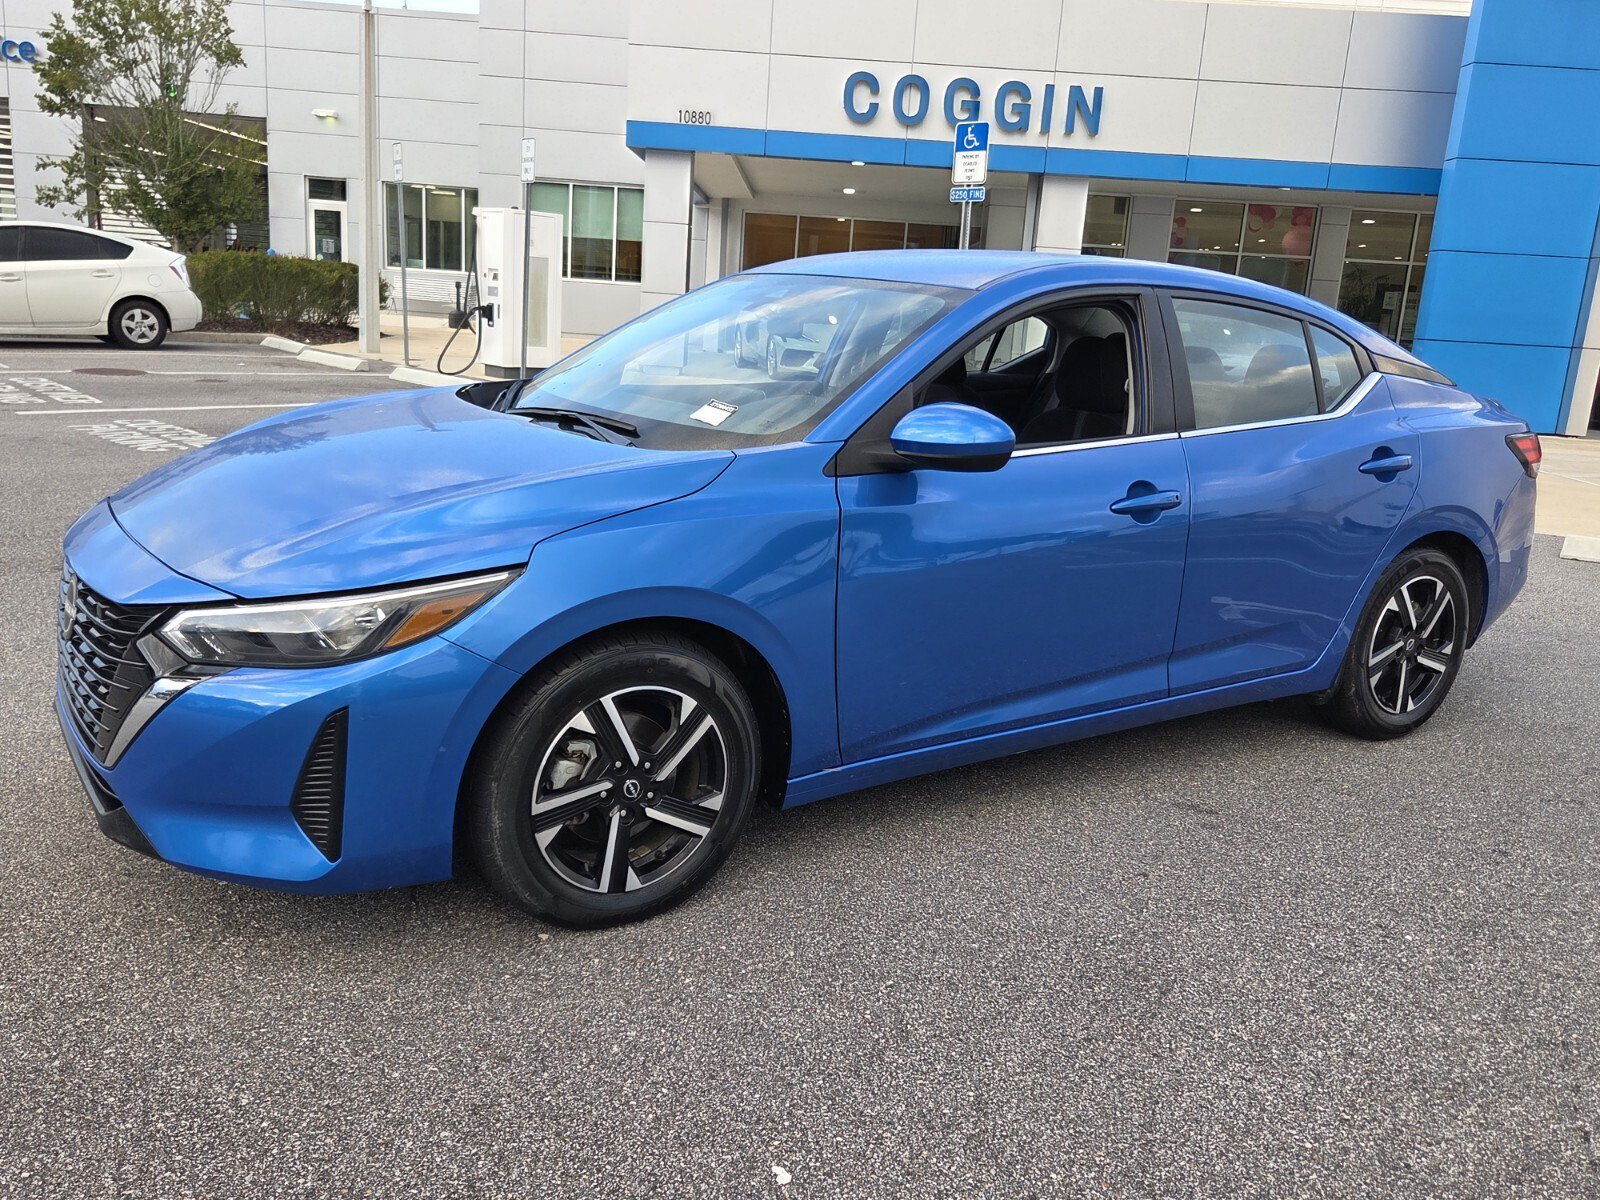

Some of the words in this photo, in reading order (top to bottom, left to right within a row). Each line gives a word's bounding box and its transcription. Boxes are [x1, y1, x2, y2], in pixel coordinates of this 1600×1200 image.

[0, 37, 36, 62] ce
[843, 71, 1104, 137] COGGIN
[679, 109, 711, 125] 10880
[951, 190, 968, 199] $250
[970, 189, 984, 198] FINE
